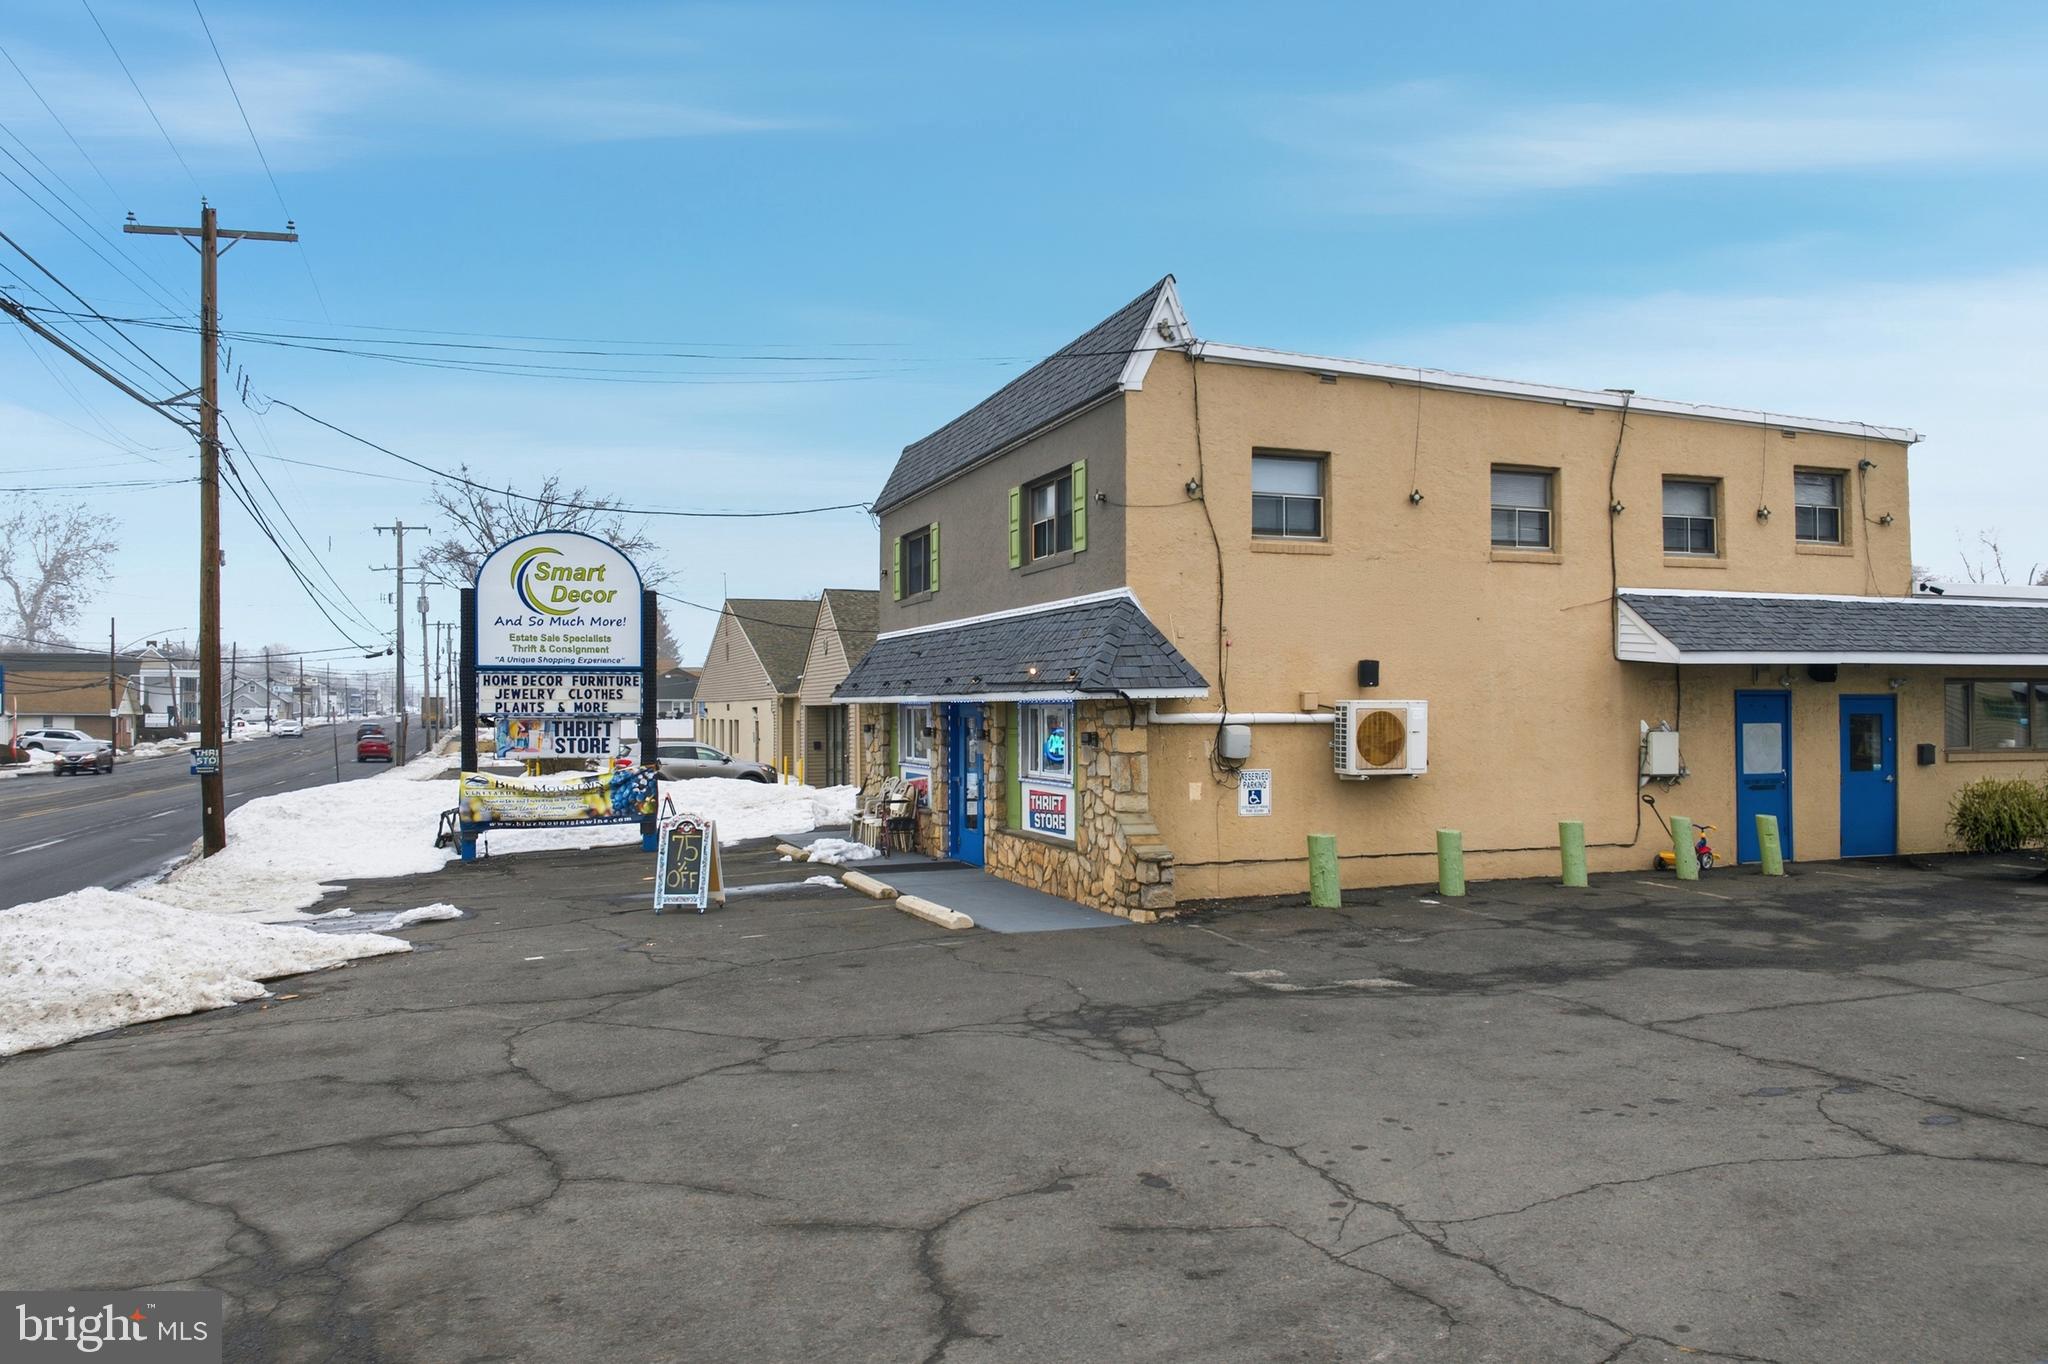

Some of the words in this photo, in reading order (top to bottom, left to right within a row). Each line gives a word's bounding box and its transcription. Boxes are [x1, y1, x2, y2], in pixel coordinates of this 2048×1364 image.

[534, 562, 607, 582] Smart
[551, 585, 617, 603] Decor
[494, 615, 522, 626] And
[528, 616, 544, 626] So
[549, 616, 585, 626] Much
[590, 616, 627, 627] More!
[509, 633, 538, 642] Estate
[540, 633, 560, 642] Sale
[563, 634, 612, 644] Specialists
[512, 644, 537, 653] Thrift
[539, 644, 546, 653] &
[549, 644, 609, 655] Consignment
[507, 656, 536, 664] Unique
[537, 656, 576, 664] Shopping
[483, 675, 518, 687] HOME
[522, 675, 563, 687] DECOR
[572, 675, 640, 687] FURNITURE
[495, 688, 555, 700] JEWELRY
[568, 688, 623, 699] CLOTHES
[495, 702, 545, 713] PLANTS
[558, 702, 565, 713] &
[574, 702, 608, 713] MORE
[552, 721, 613, 737] THRIFT
[555, 737, 610, 754] STORE
[1243, 781, 1267, 789] PARKING
[1030, 795, 1063, 811] THRIFT
[1034, 812, 1065, 830] STORE
[672, 835, 702, 861] 75
[667, 869, 698, 889] OFF
